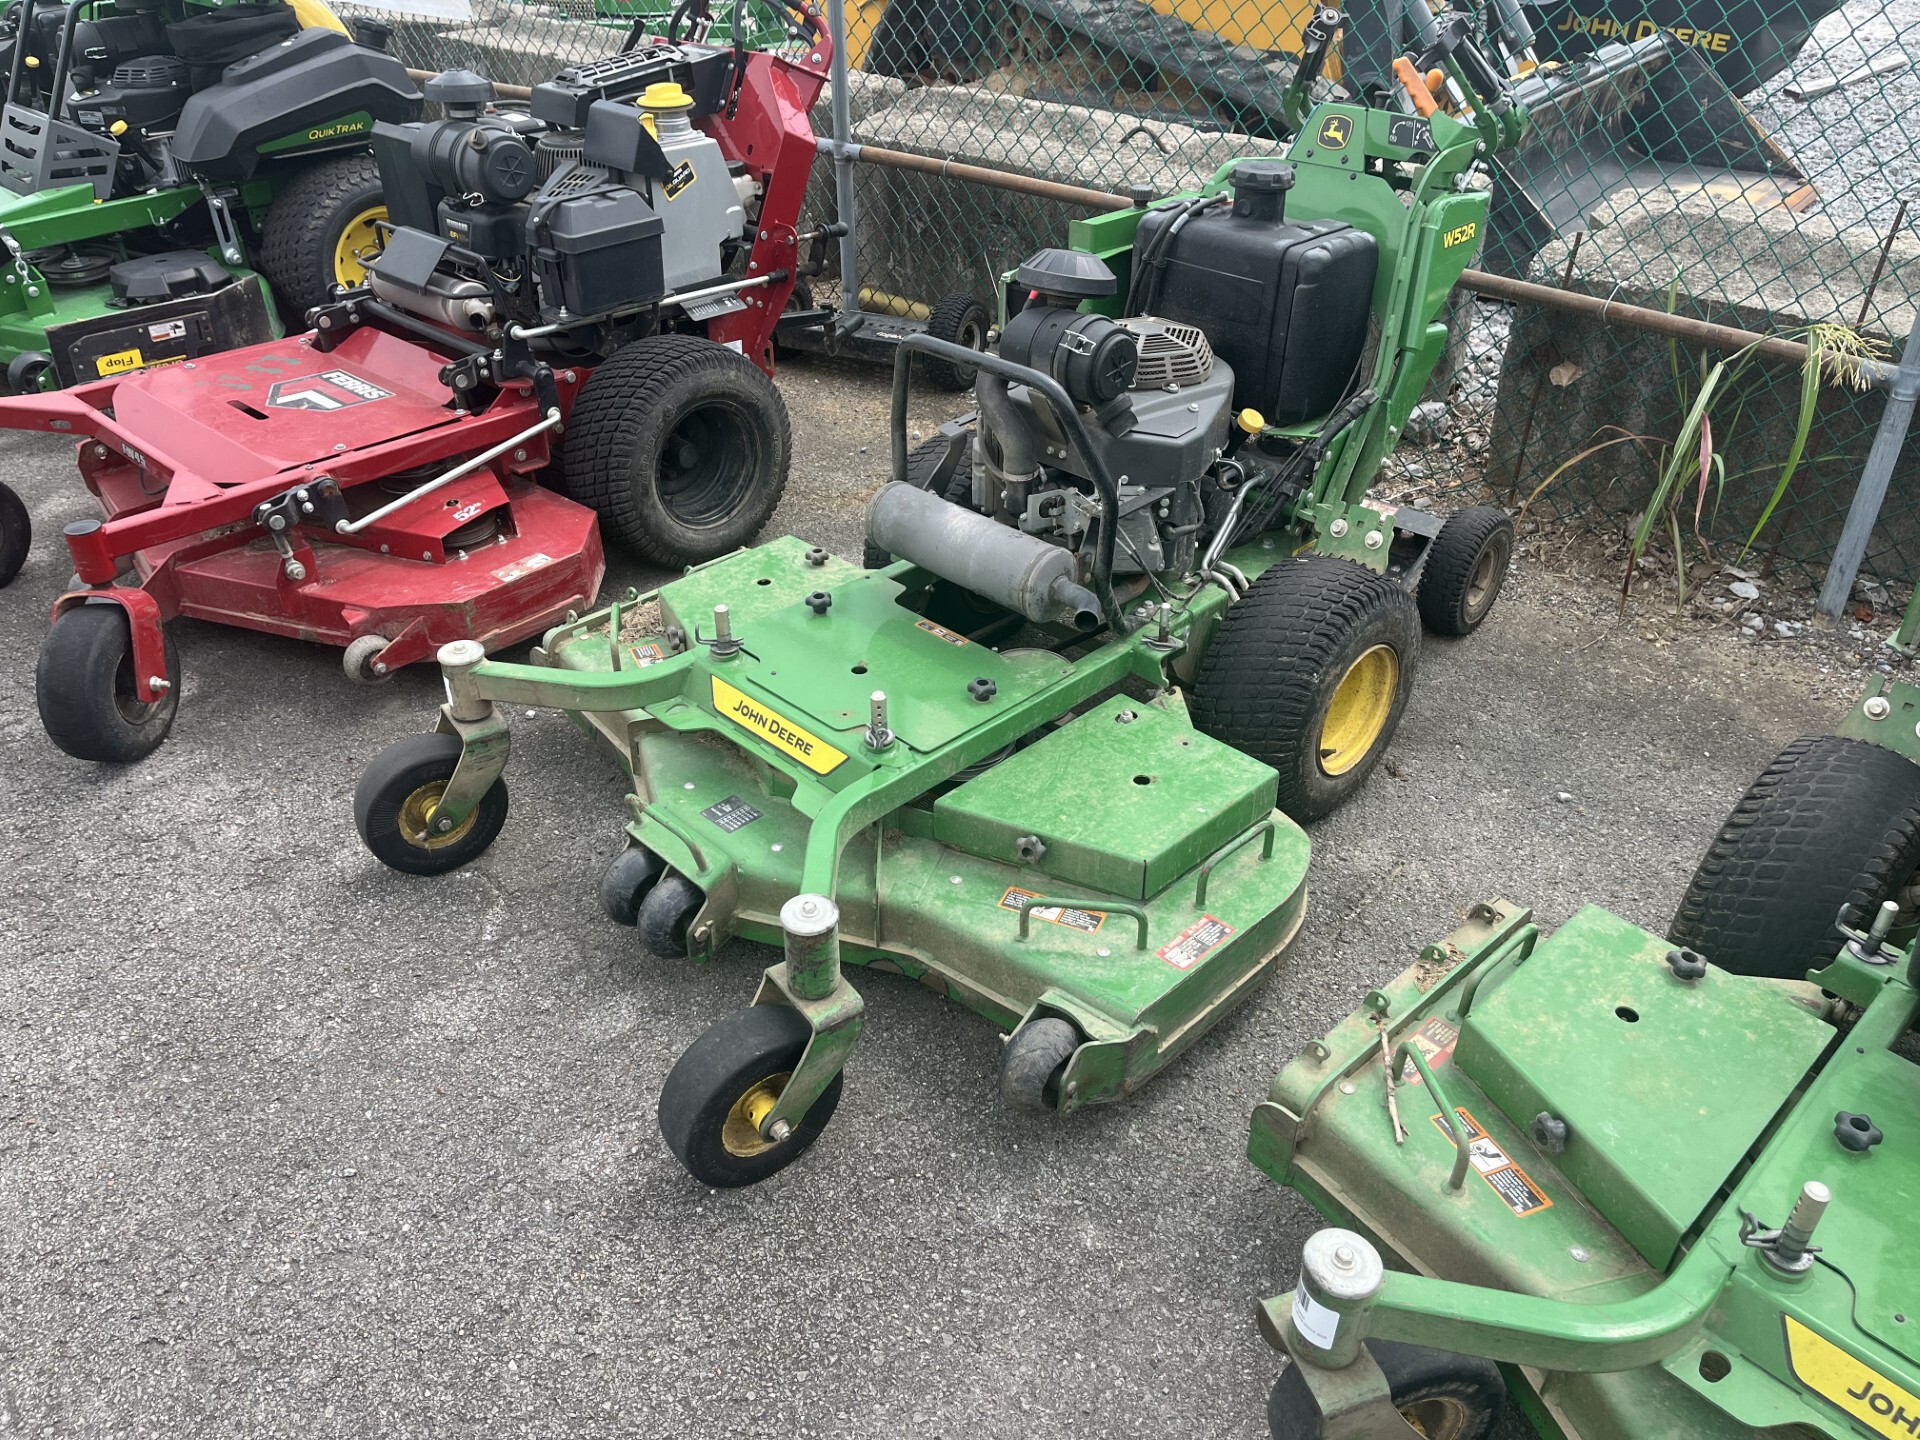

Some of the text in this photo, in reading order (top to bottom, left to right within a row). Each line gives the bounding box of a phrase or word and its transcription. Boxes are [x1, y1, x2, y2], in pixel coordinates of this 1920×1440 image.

[1557, 10, 1630, 39] JOHN
[1443, 222, 1476, 249] W52R
[106, 356, 134, 367] Flap
[321, 371, 386, 399] FERRIS
[733, 700, 814, 756] JOHN DEERE
[1846, 1380, 1920, 1440] JOH
